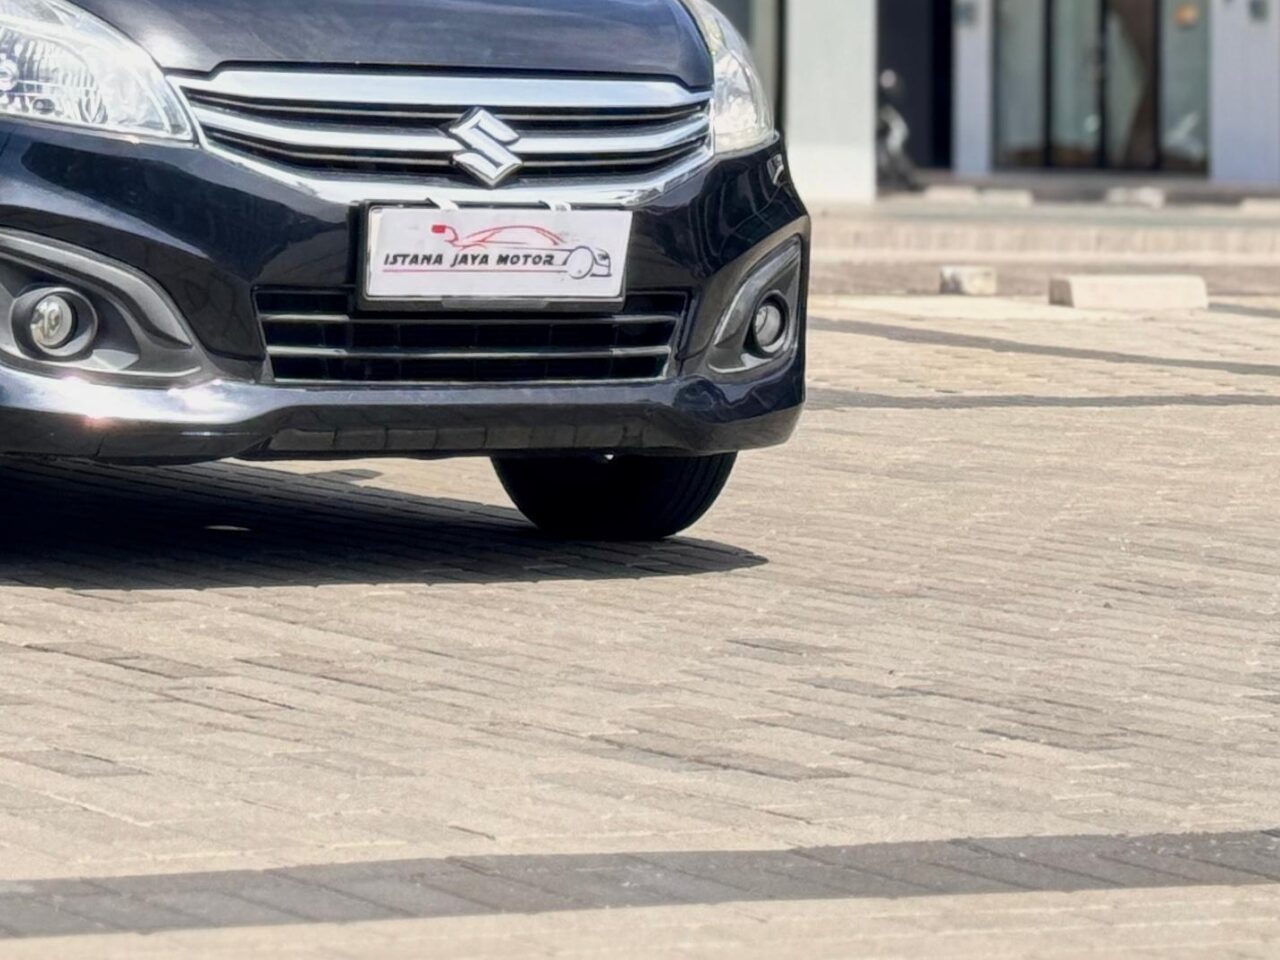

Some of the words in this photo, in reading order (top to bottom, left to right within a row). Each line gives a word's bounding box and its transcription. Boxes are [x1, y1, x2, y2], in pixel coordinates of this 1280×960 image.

[383, 253, 443, 266] ISTANA
[450, 253, 489, 268] JAYA
[496, 254, 555, 266] MOTOR
